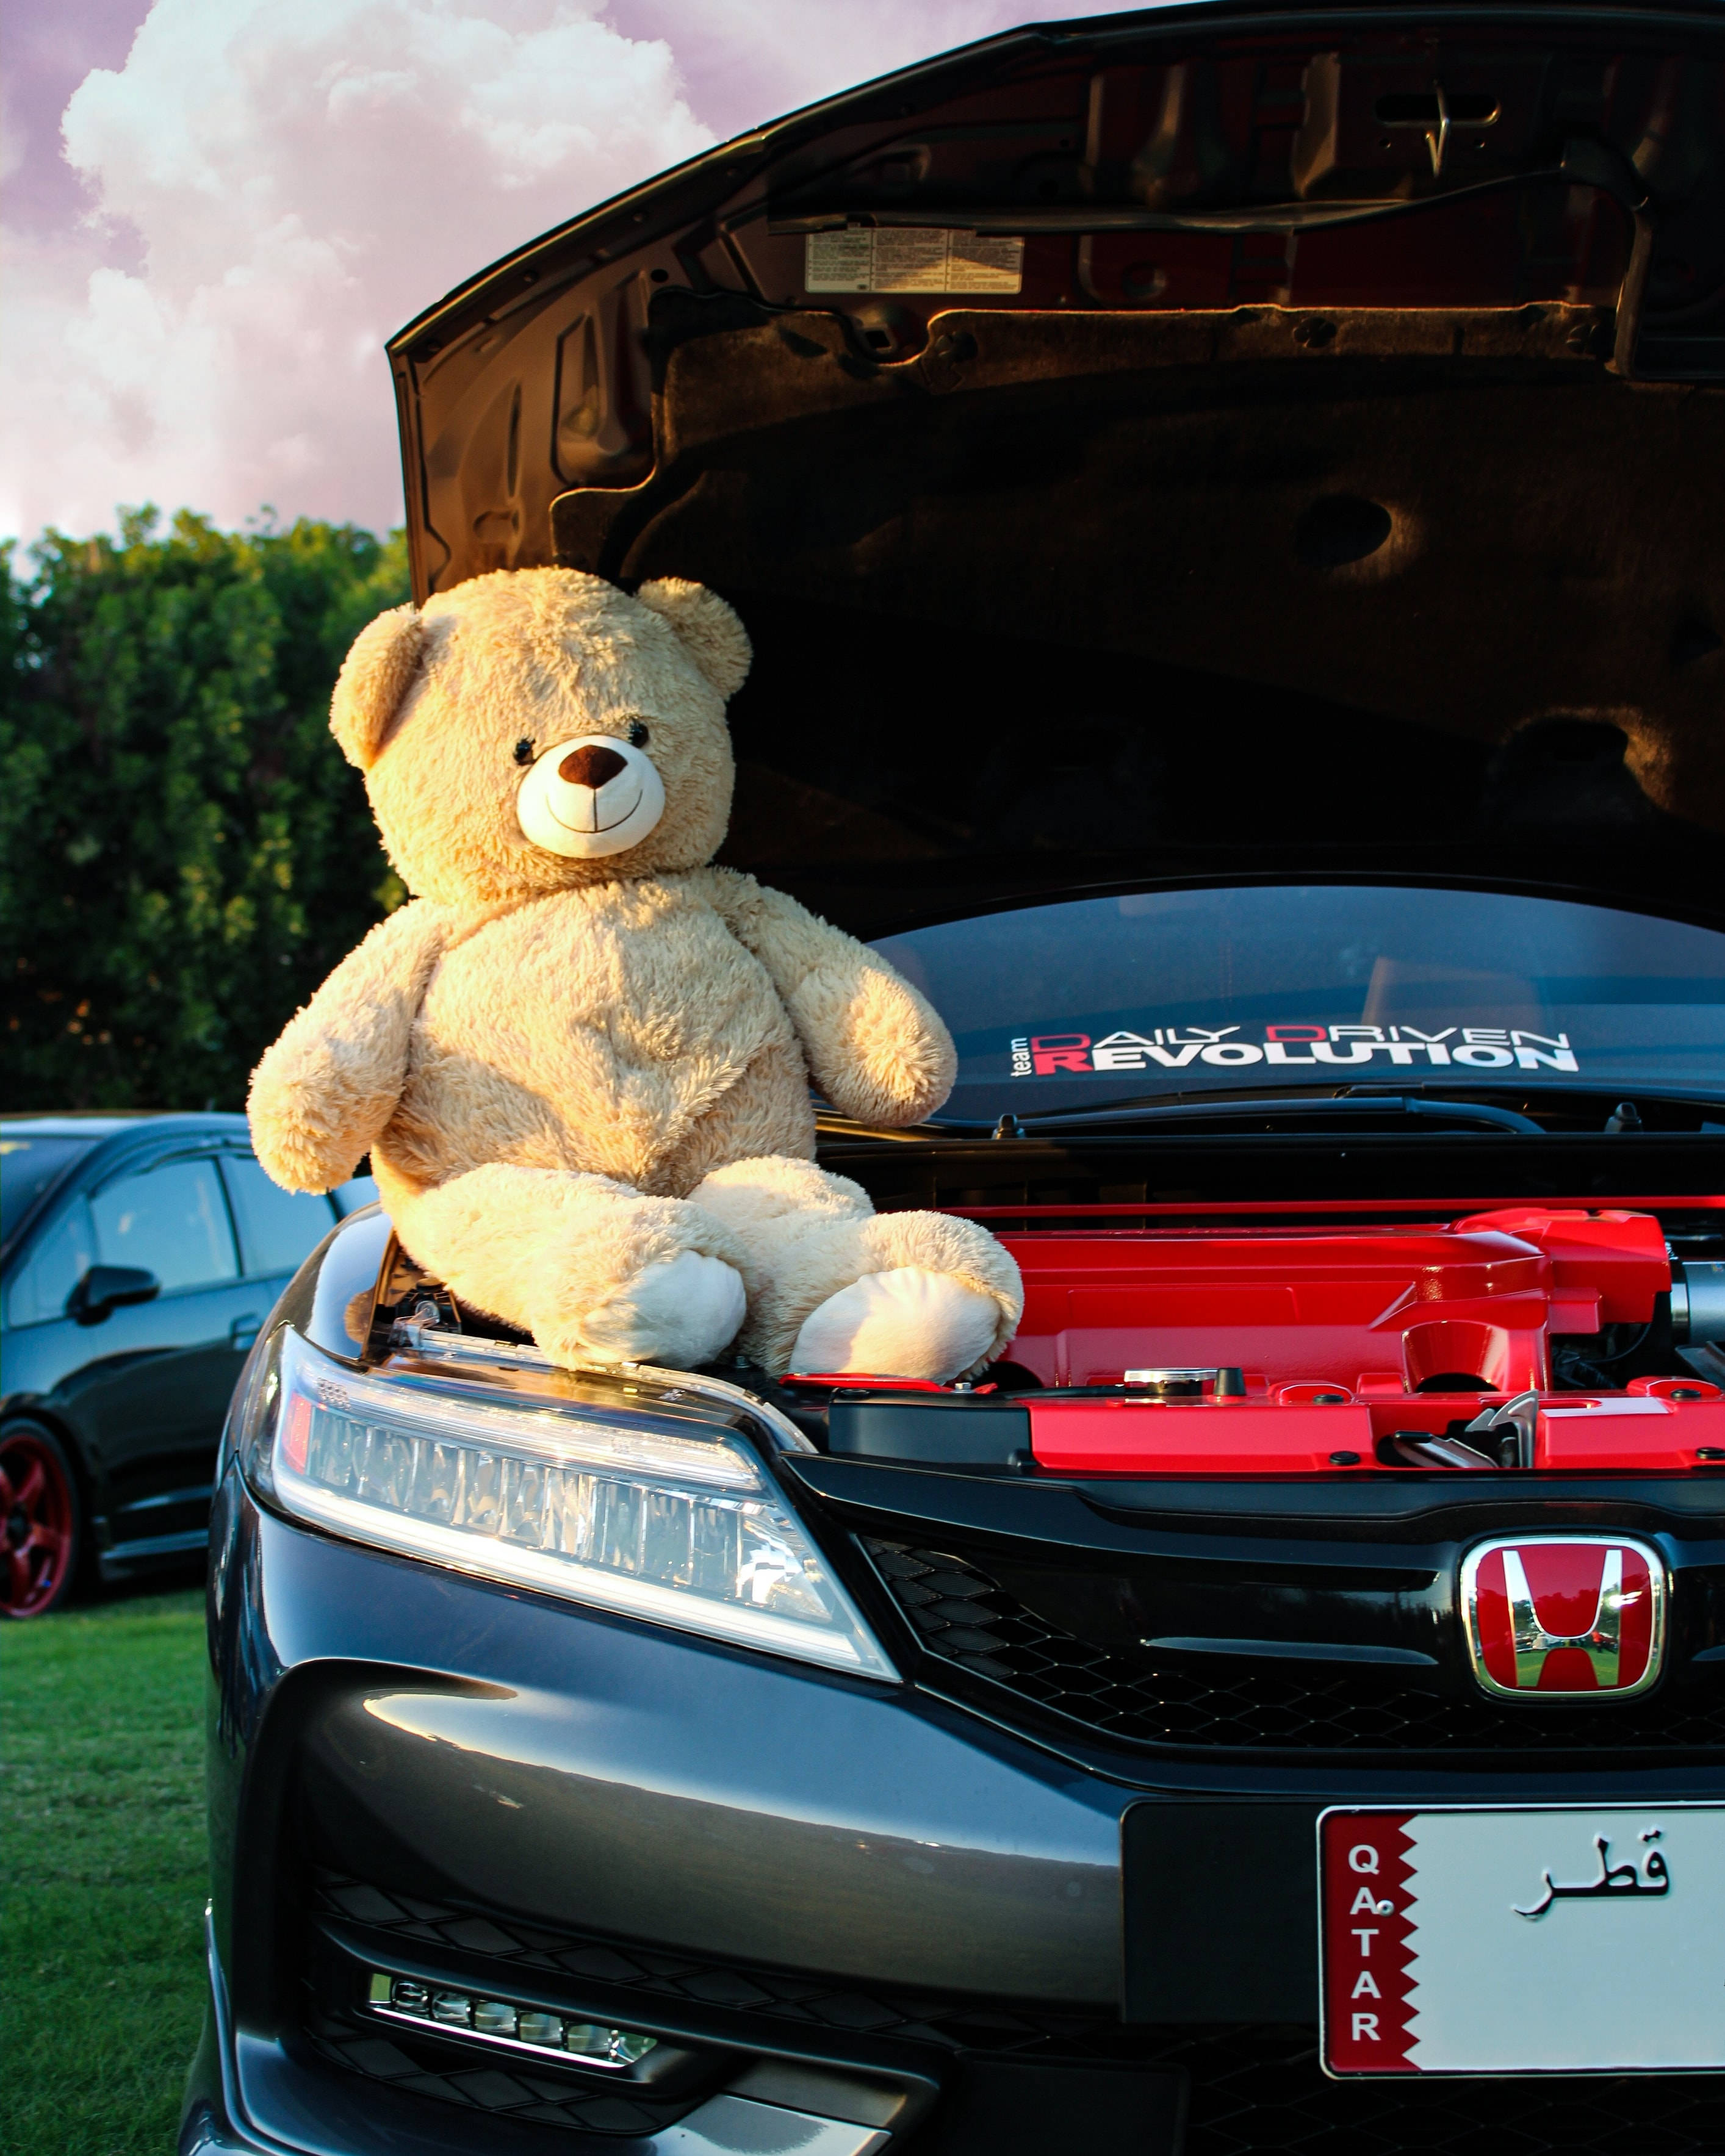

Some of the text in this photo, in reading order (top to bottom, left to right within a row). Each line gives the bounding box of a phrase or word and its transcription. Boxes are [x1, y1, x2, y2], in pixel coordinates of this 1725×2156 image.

[1011, 1037, 1032, 1077] team
[1031, 1026, 1570, 1053] DAILY DRIVEN
[1033, 1042, 1579, 1075] REVOLUTION
[1511, 1827, 1669, 1920] قطر
[1349, 1845, 1381, 2041] QATAR
